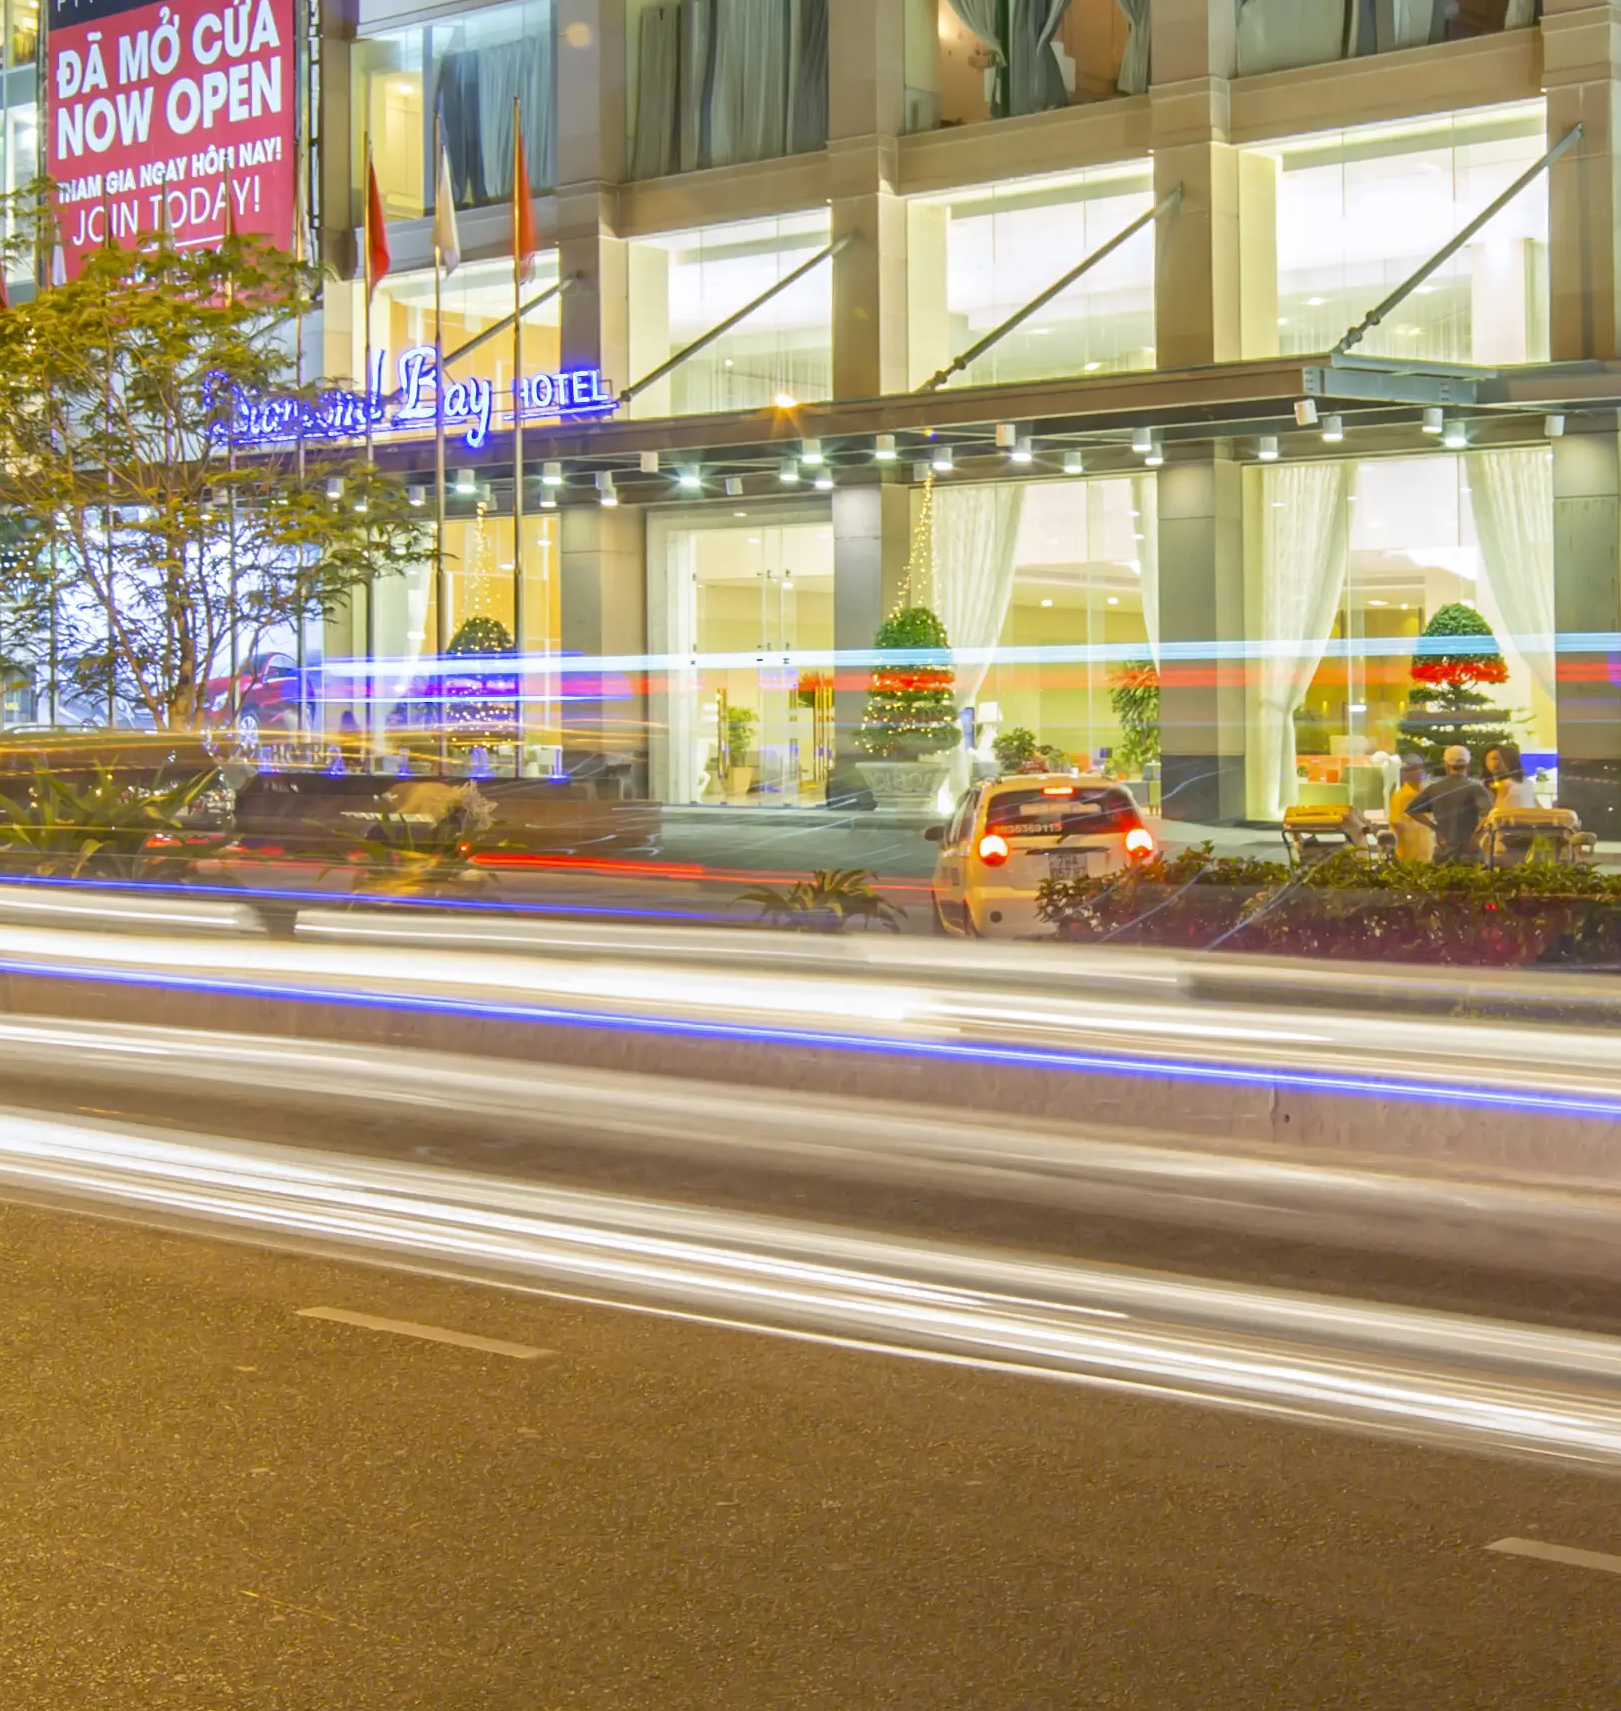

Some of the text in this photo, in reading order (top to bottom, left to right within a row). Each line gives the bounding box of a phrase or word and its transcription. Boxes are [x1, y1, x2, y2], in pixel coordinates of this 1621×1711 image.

[56, 31, 108, 100] ĐÃ
[118, 5, 180, 85] MỞ
[56, 55, 282, 160] NOW OPEN
[72, 174, 261, 247] JOIN TODAY!
[105, 167, 137, 195] GIA
[139, 155, 188, 188] NGAY
[191, 144, 235, 178] HÔM
[238, 136, 283, 168] NAY!
[396, 345, 492, 448] Bay
[511, 368, 609, 408] HOTEL
